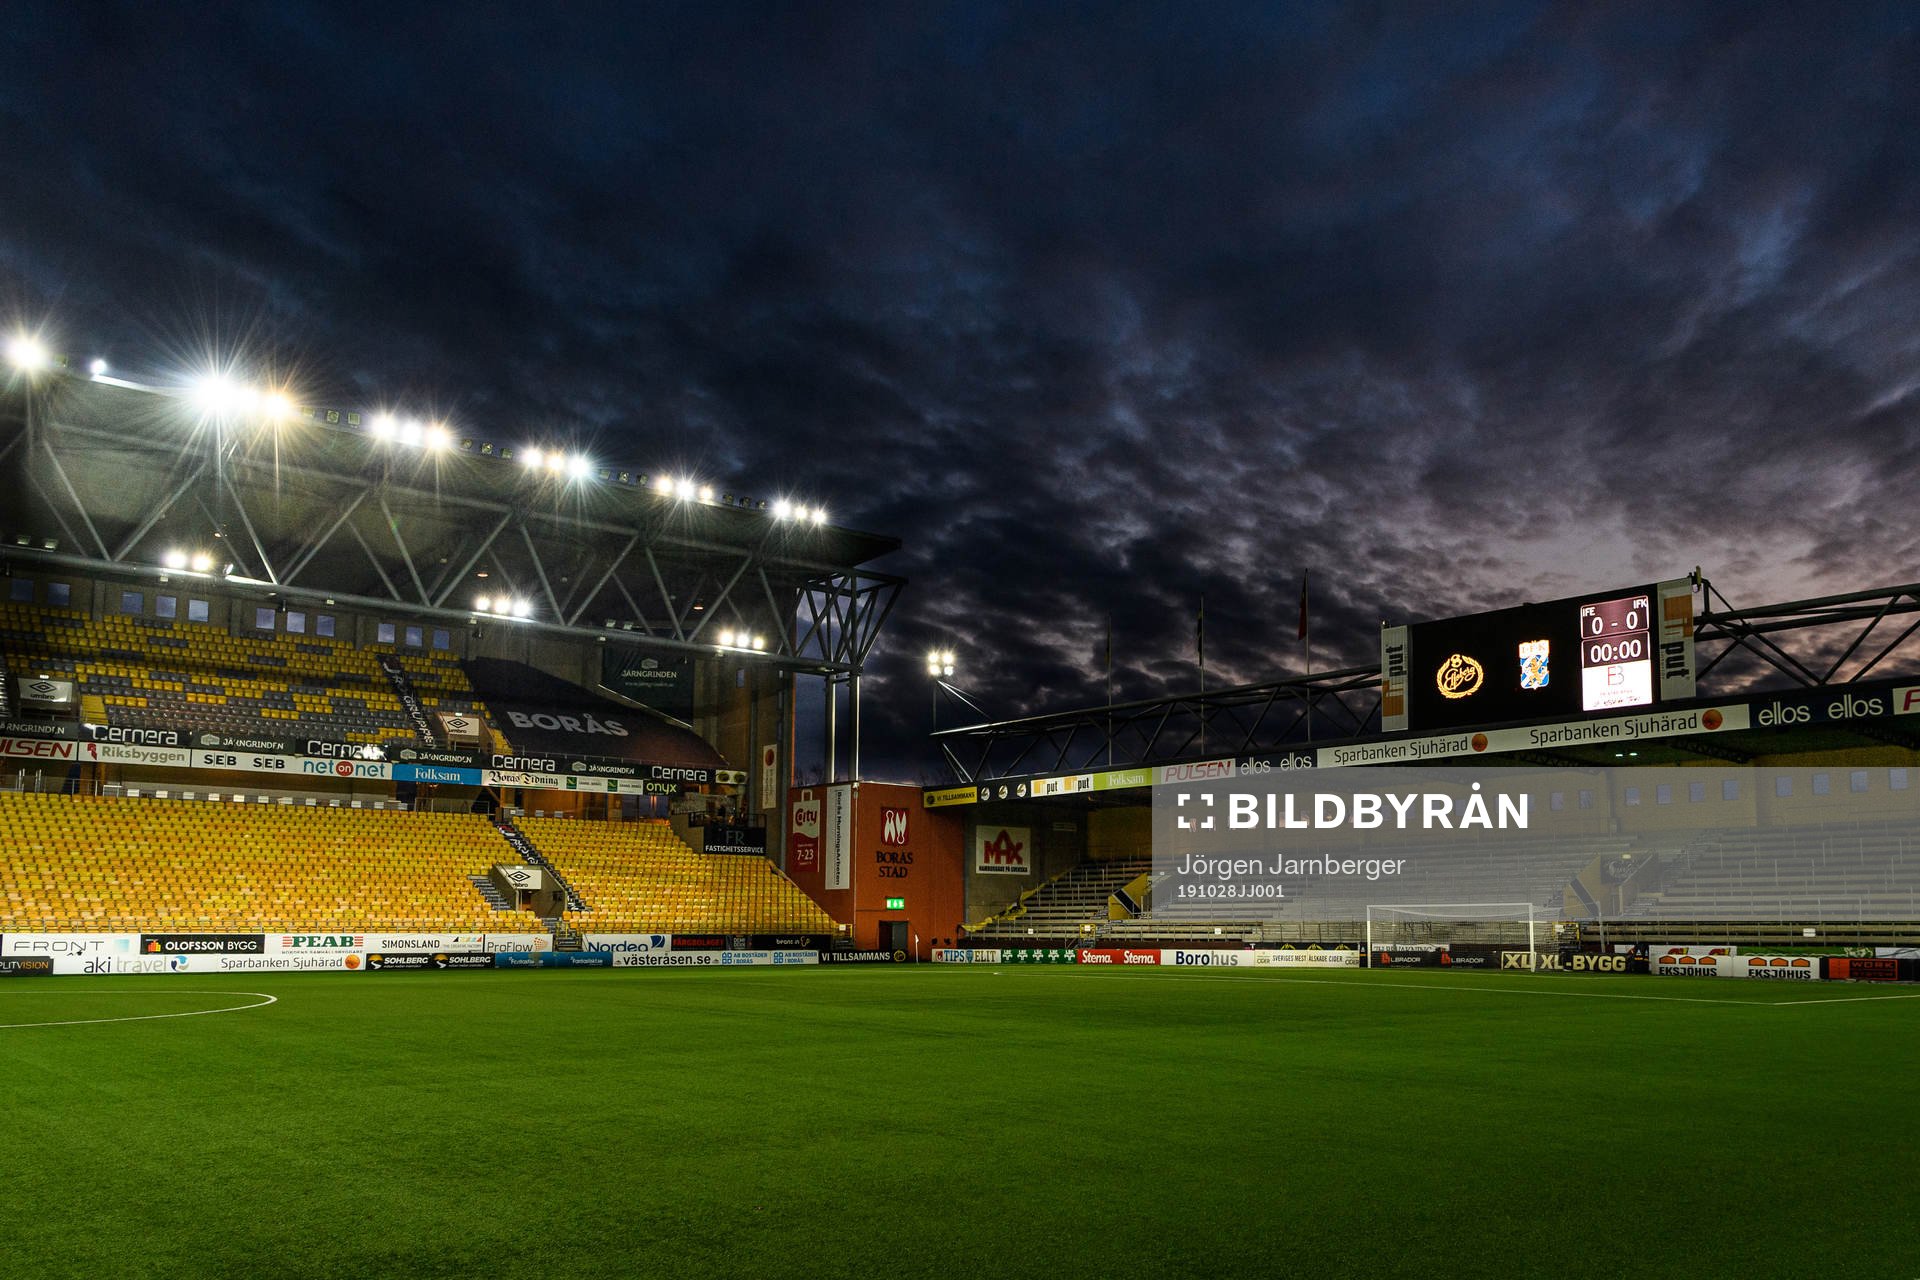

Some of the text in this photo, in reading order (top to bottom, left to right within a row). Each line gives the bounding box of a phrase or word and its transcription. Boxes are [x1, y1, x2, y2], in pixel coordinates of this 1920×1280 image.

[1582, 599, 1647, 617] IFE IFK
[1591, 616, 1604, 634] 0
[1626, 611, 1638, 629] 0
[1590, 639, 1641, 663] 00:00
[1386, 644, 1407, 677] put
[1660, 641, 1690, 679] put
[1758, 701, 1811, 726] ellos
[1828, 693, 1884, 719] ellos
[506, 712, 629, 737] BORÅS
[1530, 713, 1697, 746] Sparbanken Sjuhärad
[92, 725, 178, 745] Cernera
[102, 746, 185, 762] Riksbyggen
[1334, 736, 1468, 766] Sparbanken Sjuhärad
[203, 754, 285, 769] SEB SEB
[492, 755, 556, 772] Cernera
[1240, 752, 1312, 775] ellos ellos
[415, 768, 461, 781] Folksam
[652, 766, 707, 782] Cernera
[1165, 761, 1231, 782] PULSEN
[521, 773, 559, 786] Tidning
[1046, 778, 1090, 794] put put
[1108, 773, 1144, 786] Folksam
[646, 782, 677, 795] onyx
[795, 807, 817, 827] City
[705, 844, 764, 853] FASTIGHETSSERVICE
[797, 848, 814, 860] 7-23
[983, 829, 1024, 865] MAX
[879, 866, 908, 878] STAD
[14, 941, 104, 951] FRONT
[165, 941, 257, 950] OLOFSSON BYGG
[292, 936, 354, 947] PEAB
[381, 939, 440, 949] SIMONSLAND
[487, 941, 533, 952] ProFlow
[588, 941, 649, 952] Nordea
[221, 957, 343, 970] Sparbanken Sjuhärad
[383, 956, 491, 964] SOHLBERG SOHLBERG
[623, 952, 711, 966] västeråsen.se
[822, 951, 890, 961] VI TILLSAMMANS
[943, 950, 997, 962] TIPS ELIT
[1175, 951, 1238, 965] Borohus
[1504, 954, 1626, 972] XL XL-BYGG
[84, 956, 166, 973] aki travel
[1659, 966, 1717, 976] EKSJÖHUS
[1748, 968, 1811, 979] EKSJÖHUS
